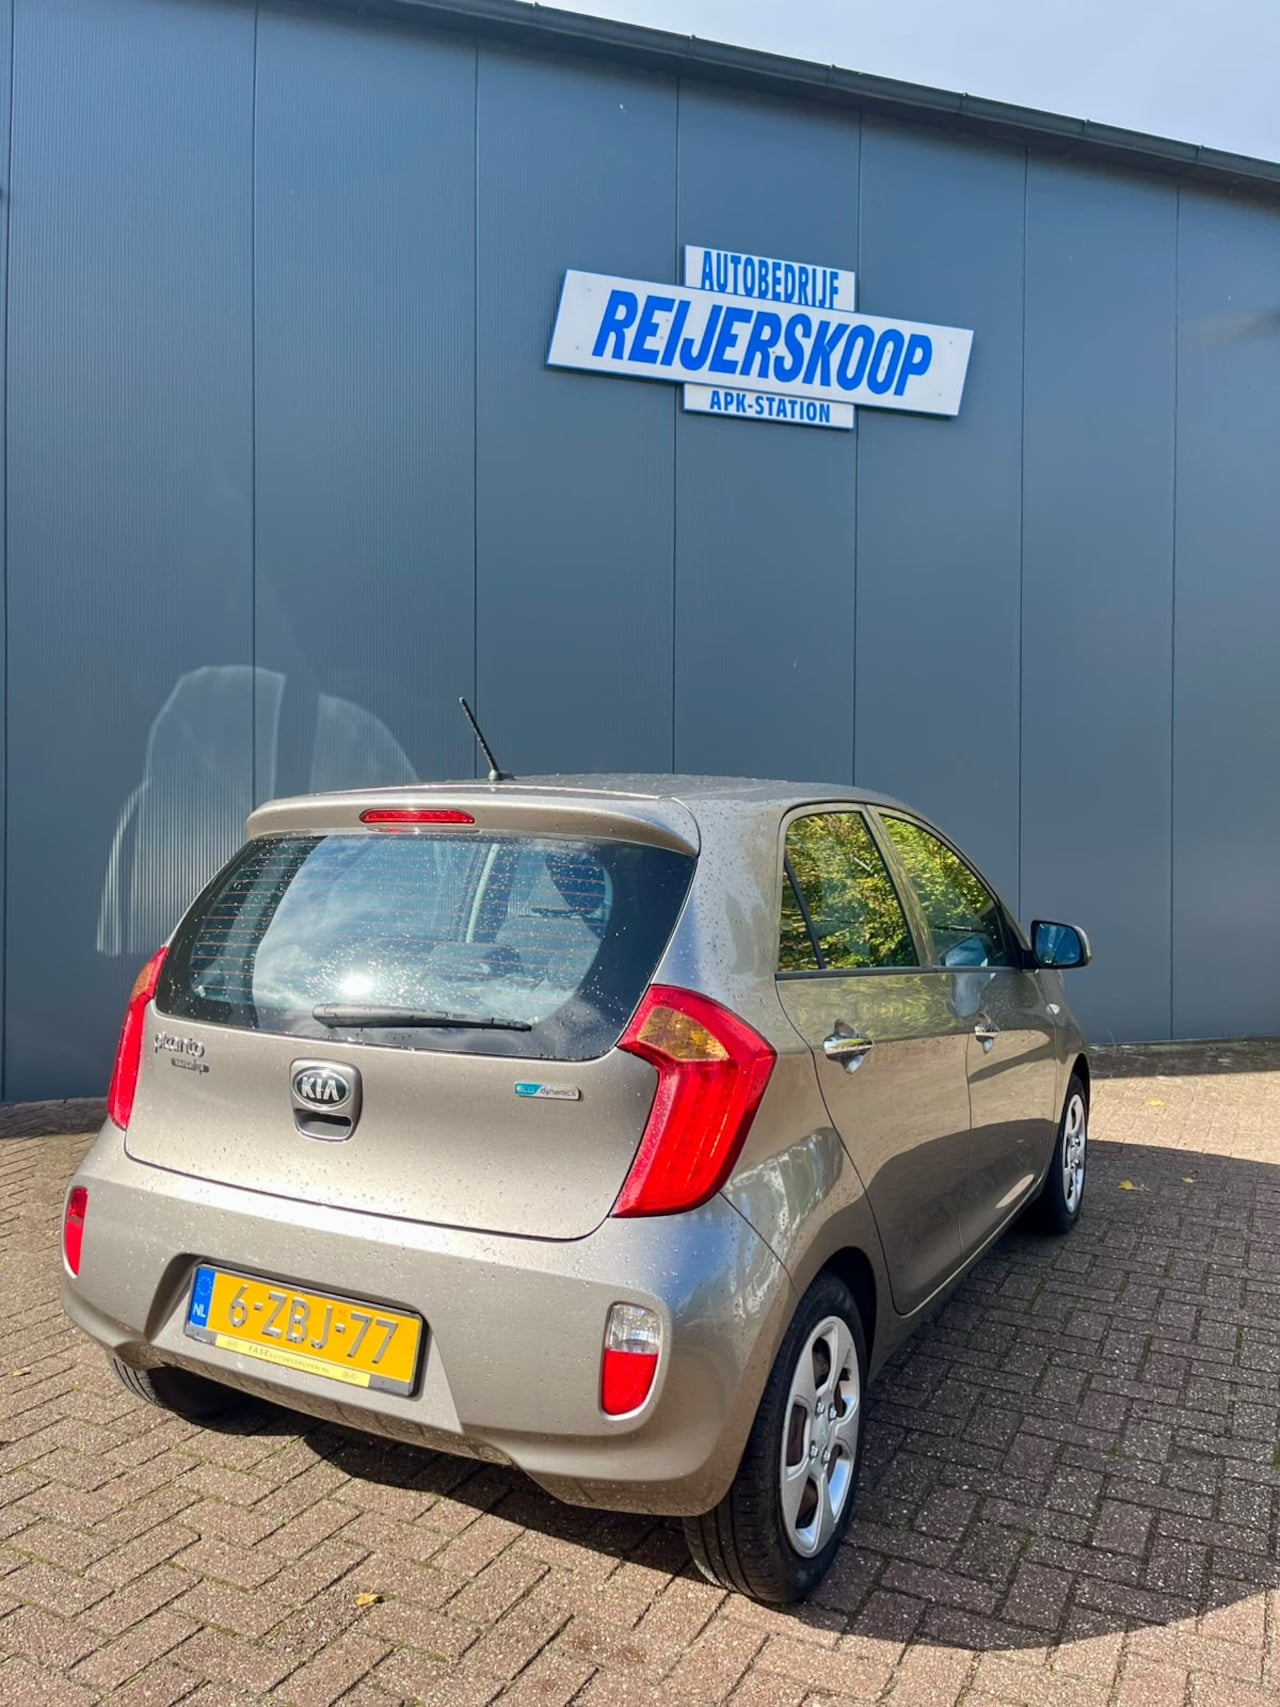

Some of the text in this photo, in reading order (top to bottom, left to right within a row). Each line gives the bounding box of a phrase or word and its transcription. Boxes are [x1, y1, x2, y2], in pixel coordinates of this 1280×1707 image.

[700, 250, 840, 309] AUTOBEDRIJF
[592, 289, 933, 397] REIJERSKOOP
[710, 390, 831, 424] APK-STATION
[301, 1076, 340, 1101] KIA
[192, 1303, 206, 1318] NL
[227, 1284, 400, 1366] 6-ZBJ-77
